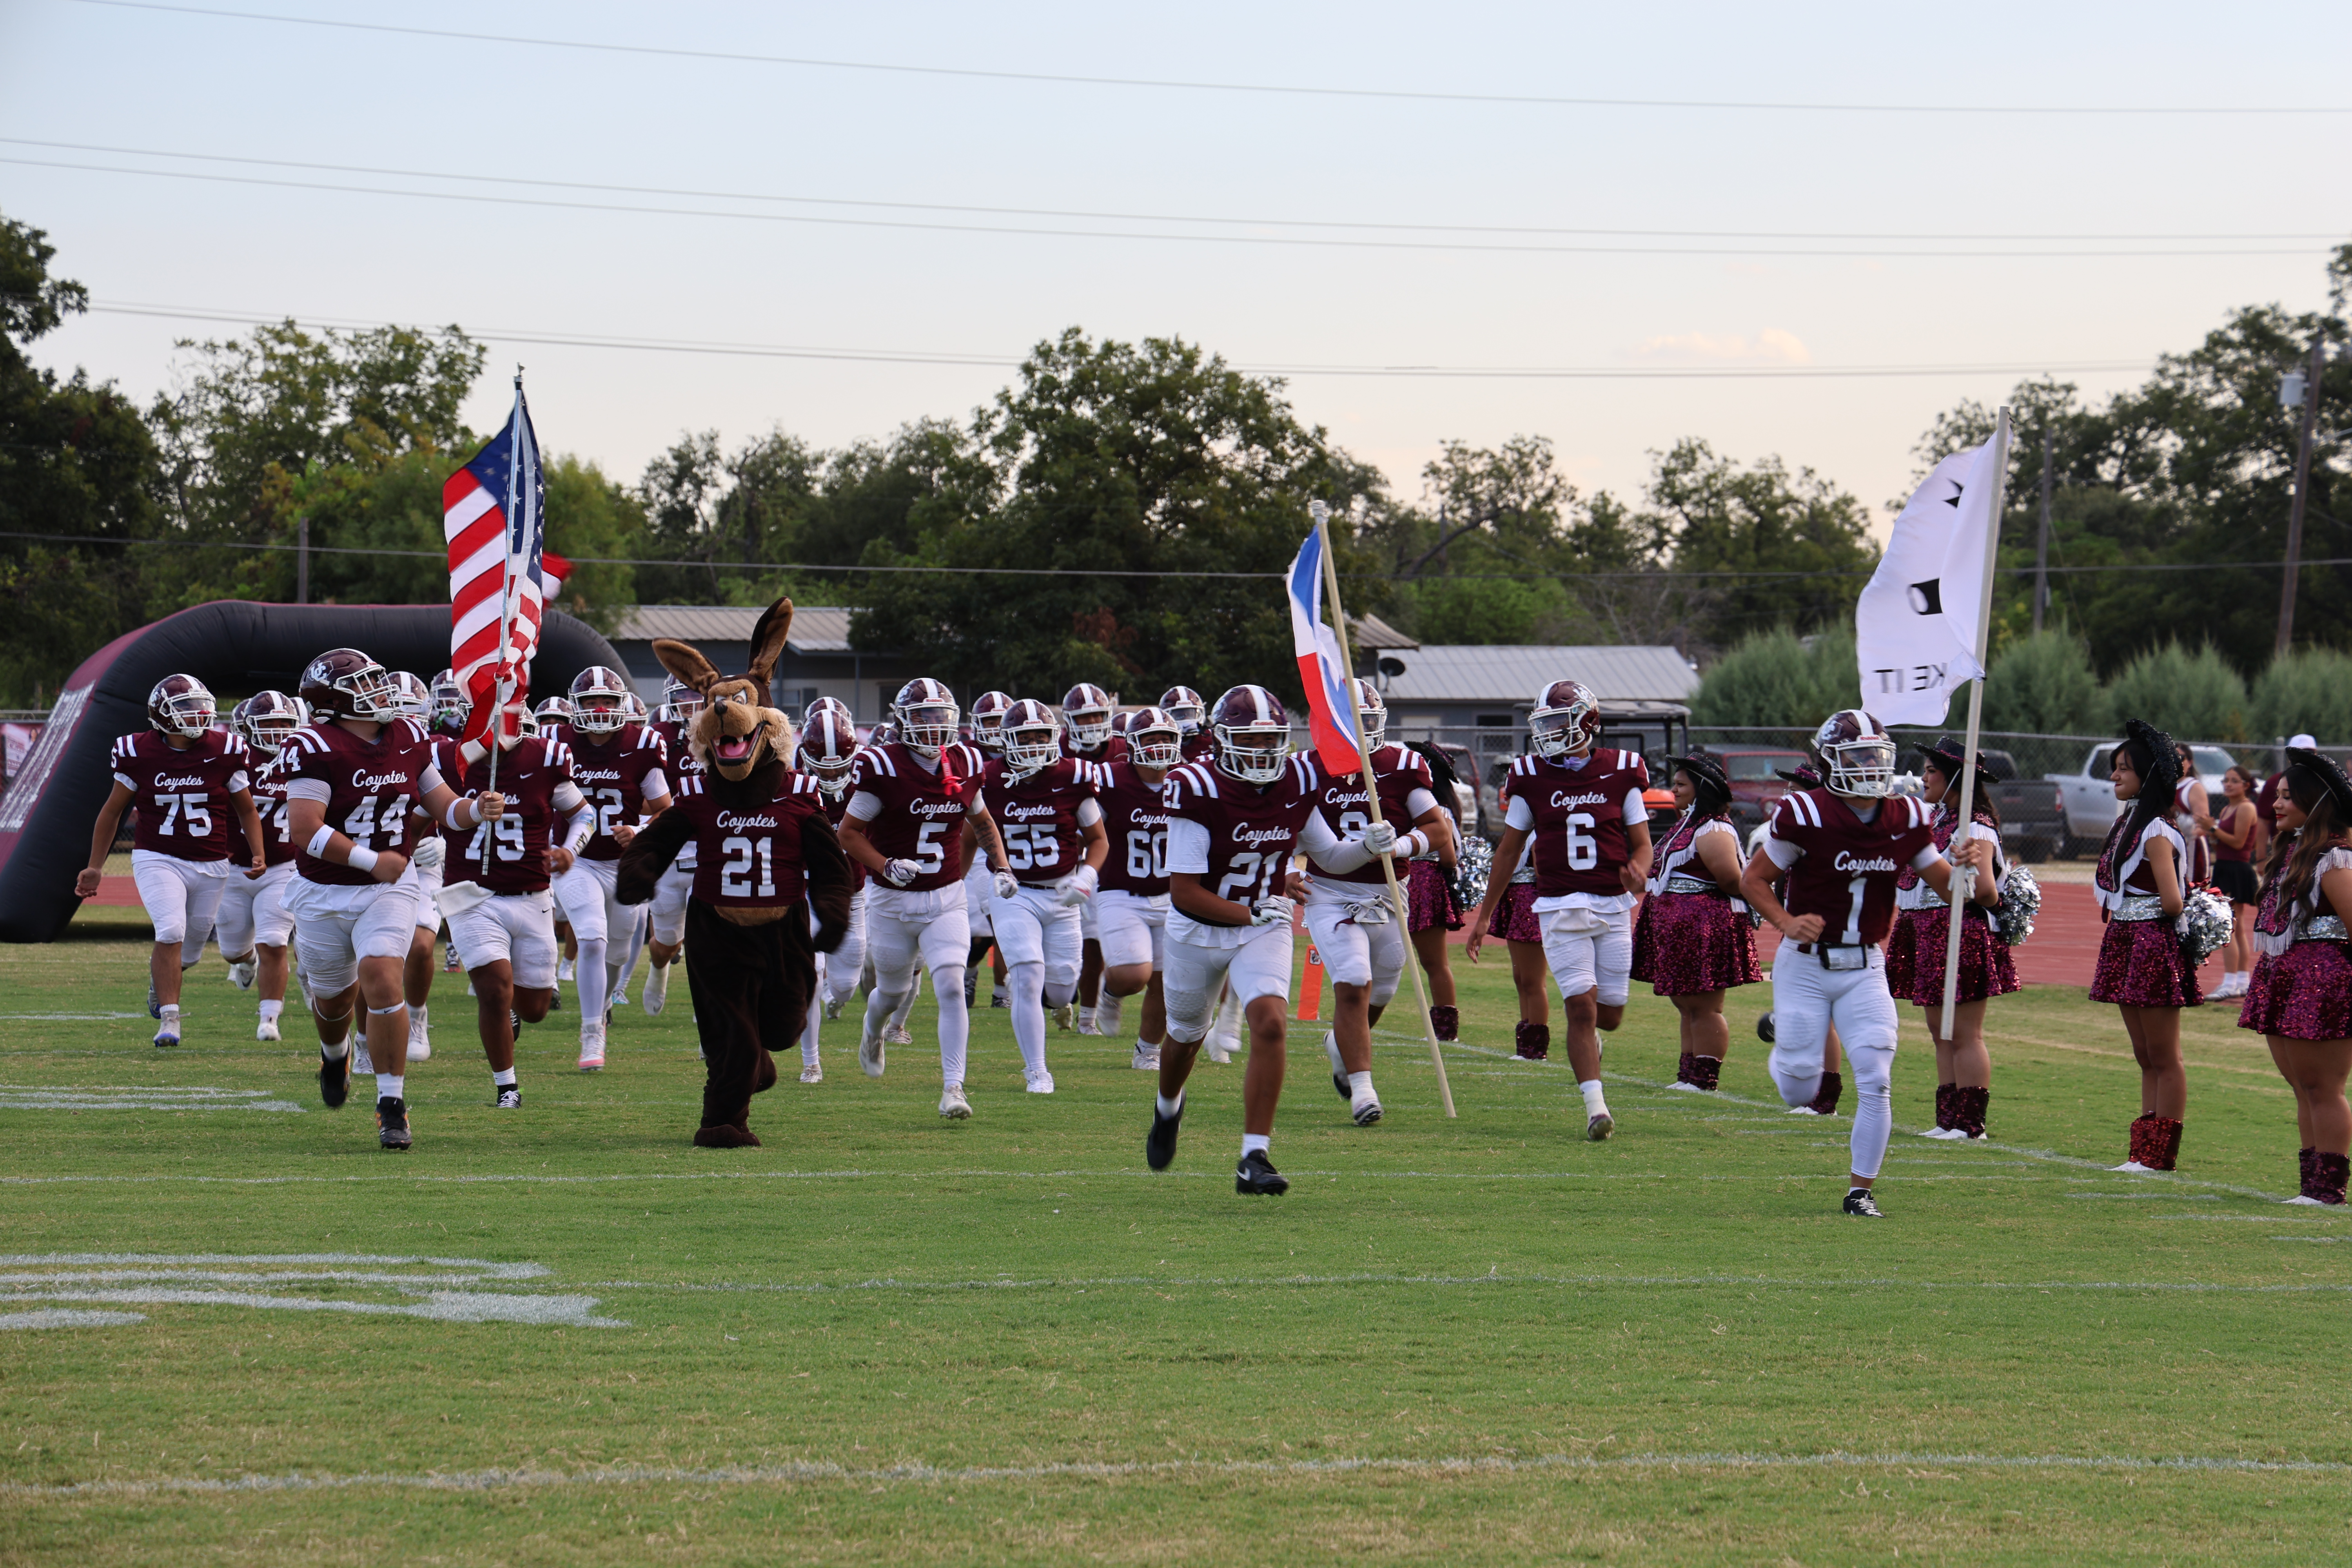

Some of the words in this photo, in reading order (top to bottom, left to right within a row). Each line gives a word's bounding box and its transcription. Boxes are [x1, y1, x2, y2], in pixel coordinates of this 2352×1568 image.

[278, 746, 301, 772] 44
[852, 760, 863, 784] 5
[155, 772, 204, 791] Coyotes
[255, 777, 288, 797] Coyot
[352, 769, 408, 792] Coyotes
[573, 764, 621, 784] Coyotes
[1163, 779, 1181, 809] 21
[1550, 790, 1608, 811] Coyotes
[155, 793, 212, 837] 75
[345, 794, 410, 849] 44
[717, 810, 778, 834] Coyotes
[910, 798, 963, 820] Coyotes
[1004, 802, 1056, 822] Coyotes
[1131, 808, 1170, 828] Coyote
[915, 822, 948, 873] 5
[1003, 824, 1059, 869] 55
[1232, 822, 1292, 849] Coyotes
[1566, 813, 1597, 870] 6
[721, 837, 775, 897] 21
[1127, 830, 1171, 878] 60
[1834, 851, 1897, 877] Coyotes
[1217, 851, 1283, 906] 21
[1842, 878, 1867, 944] 1
